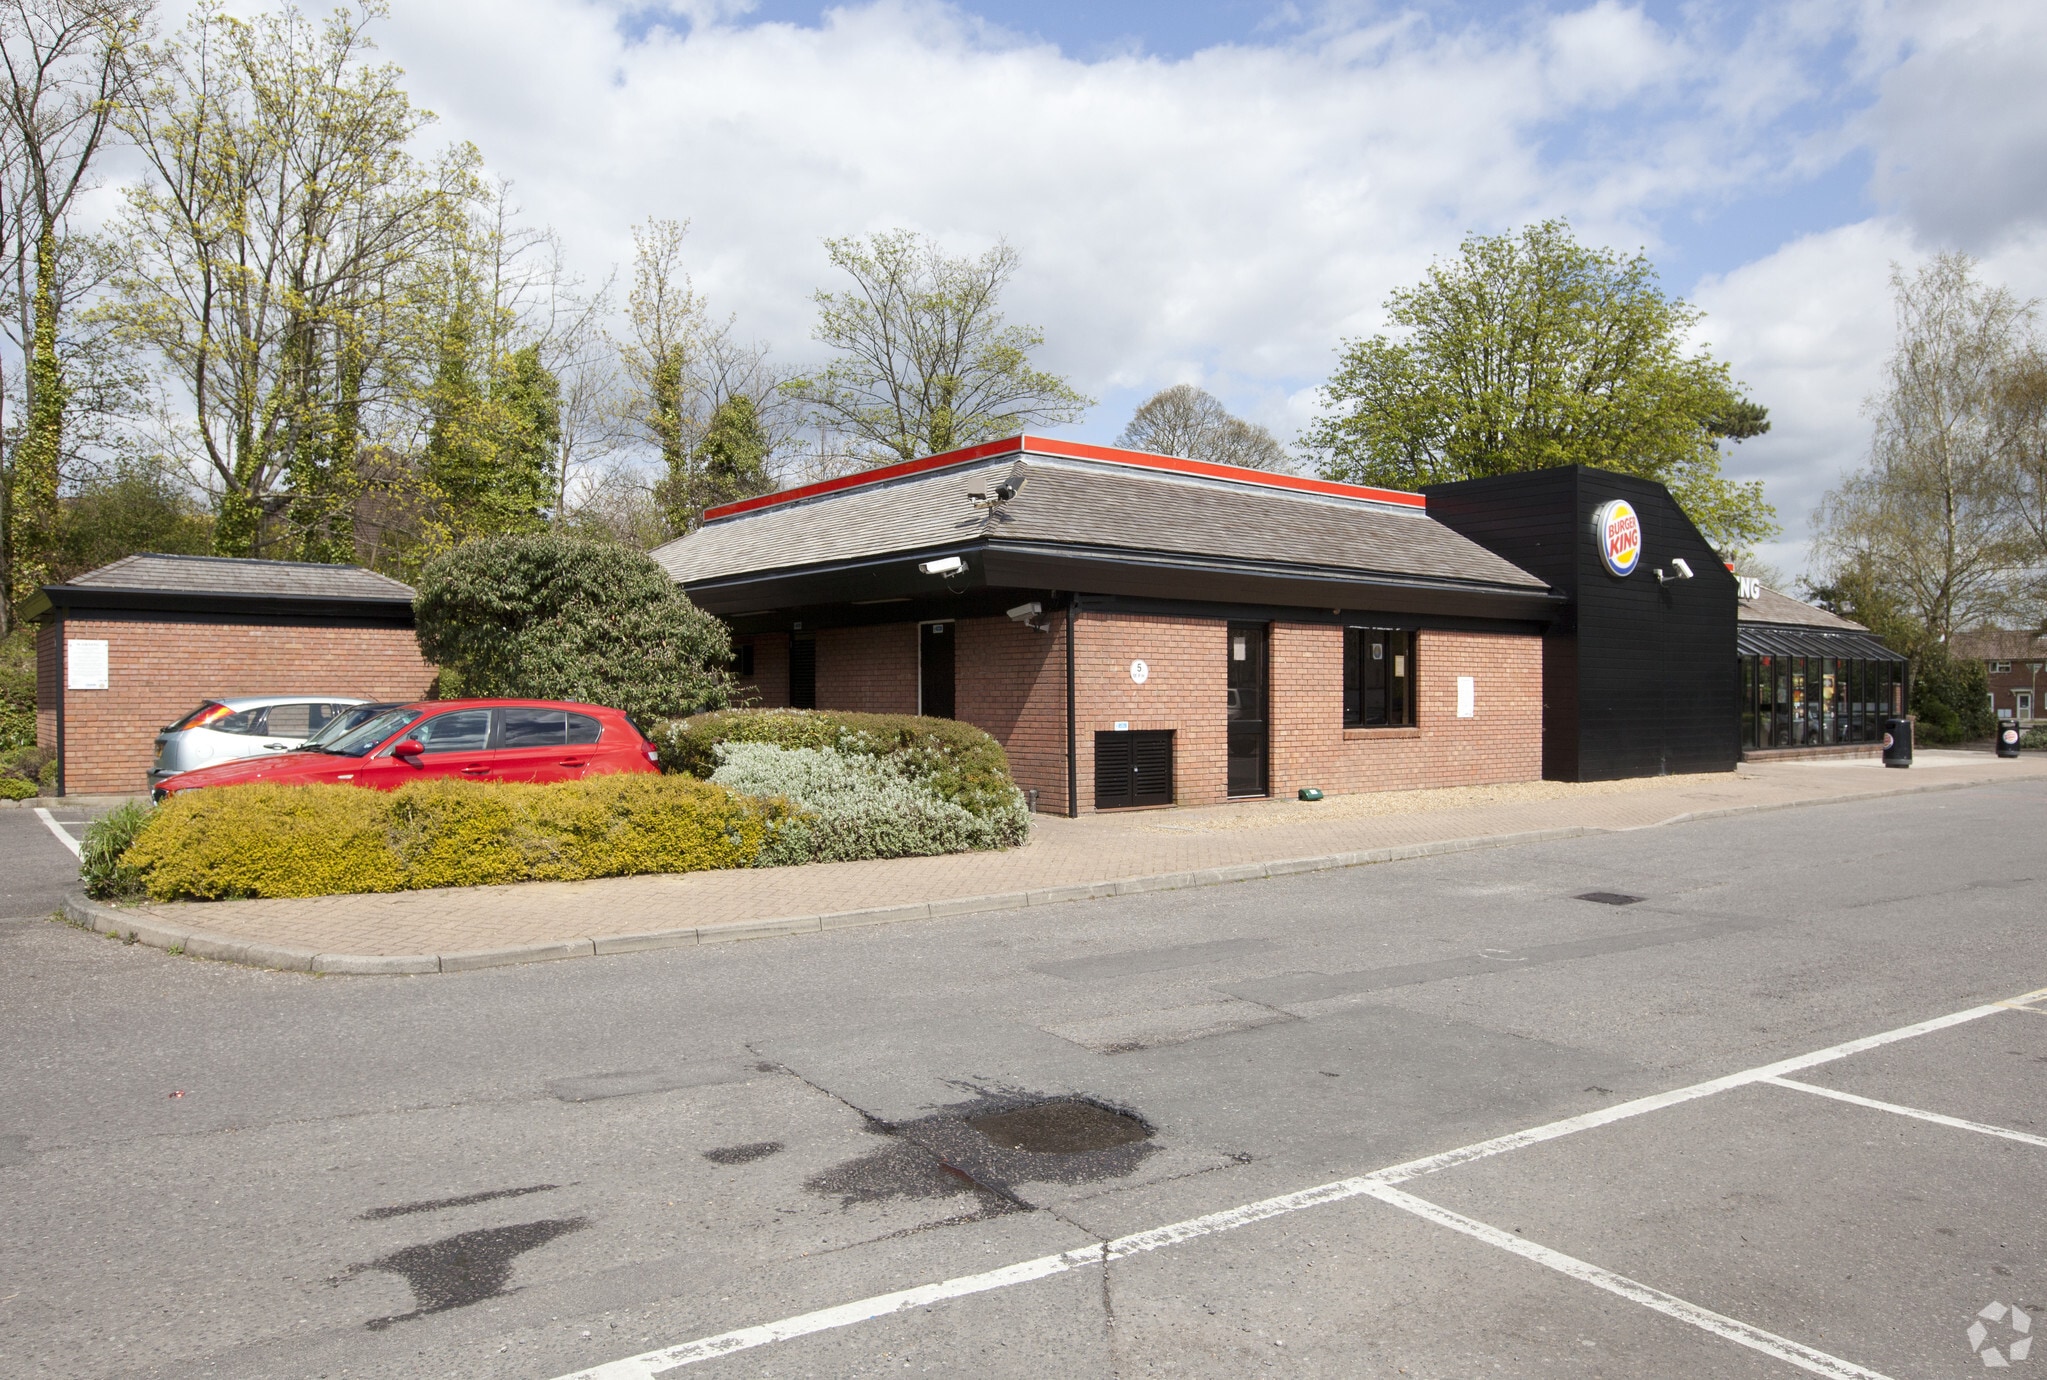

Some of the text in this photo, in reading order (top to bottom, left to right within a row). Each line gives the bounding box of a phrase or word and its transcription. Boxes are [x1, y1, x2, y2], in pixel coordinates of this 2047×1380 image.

[1608, 517, 1636, 538] BURGER
[1609, 529, 1638, 558] KING
[1137, 663, 1142, 673] 5
